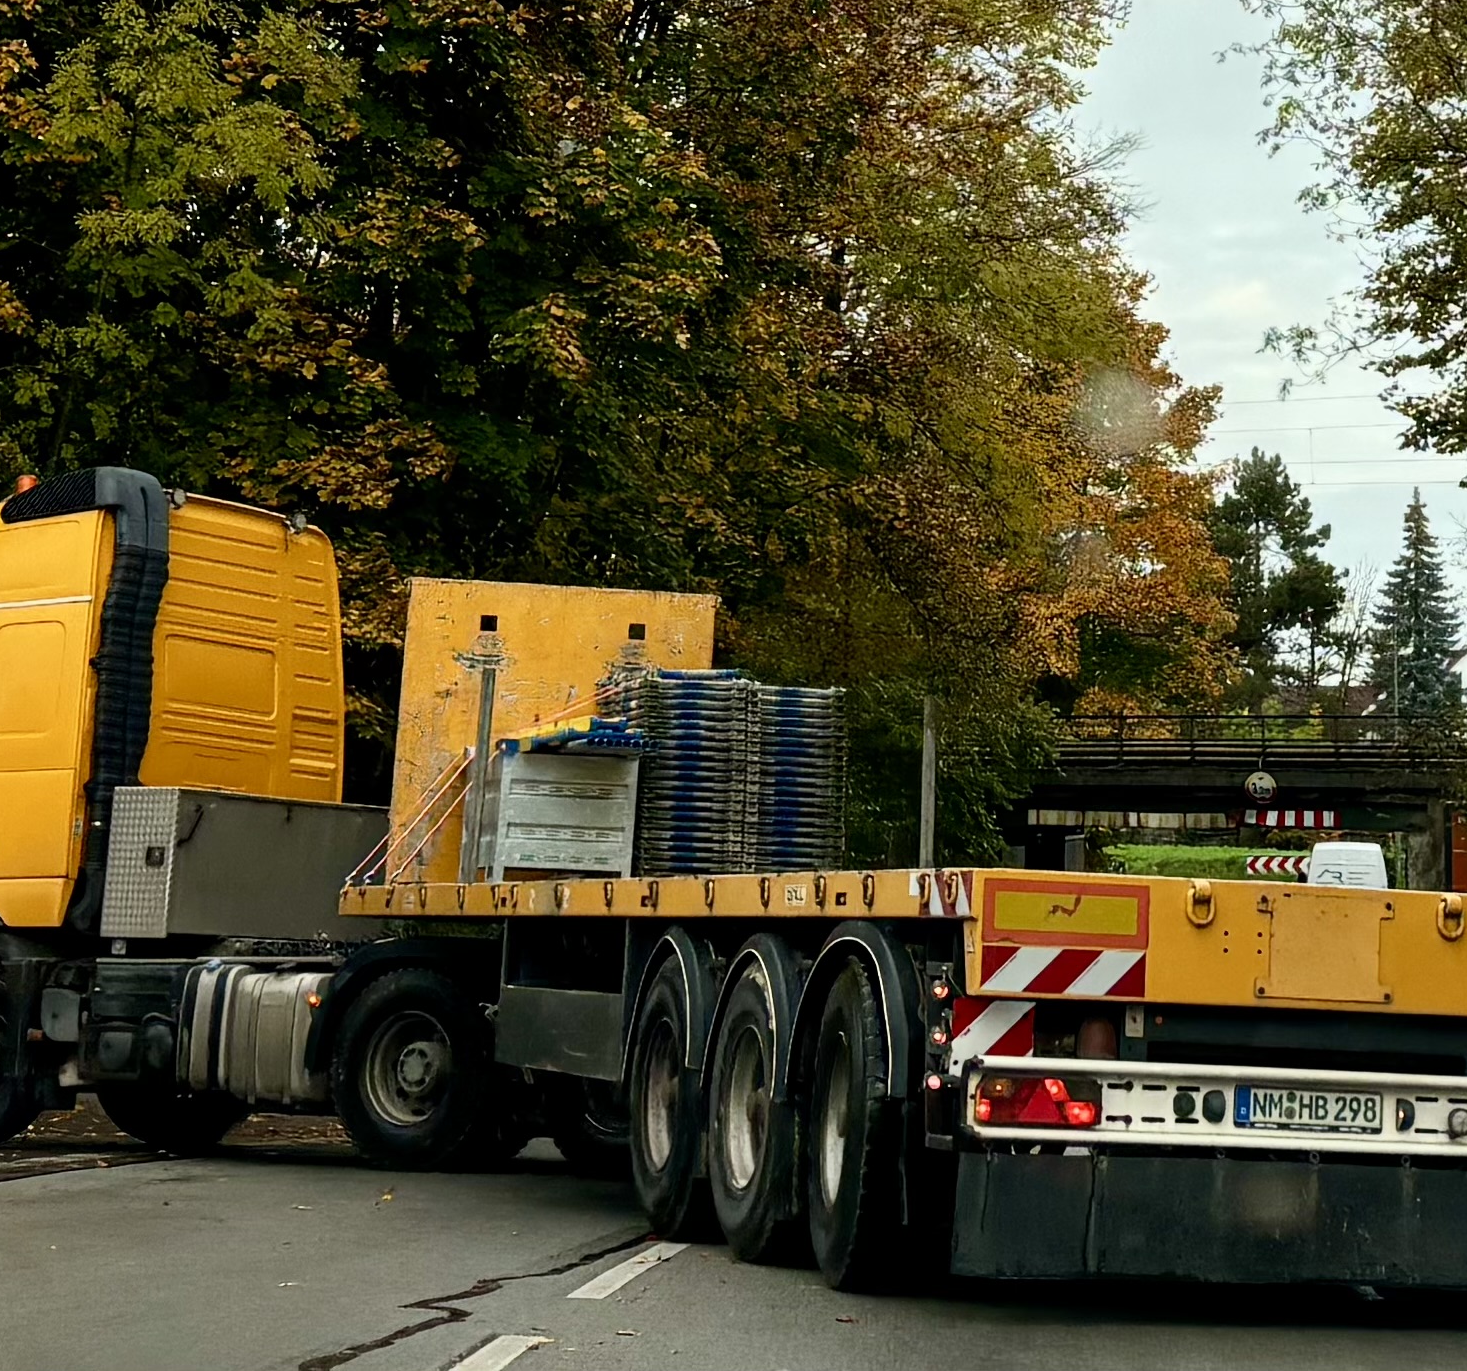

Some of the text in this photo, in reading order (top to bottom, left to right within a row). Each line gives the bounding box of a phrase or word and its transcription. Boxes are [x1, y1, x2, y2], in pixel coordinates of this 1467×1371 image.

[1252, 1091, 1377, 1123] NM HB 298
